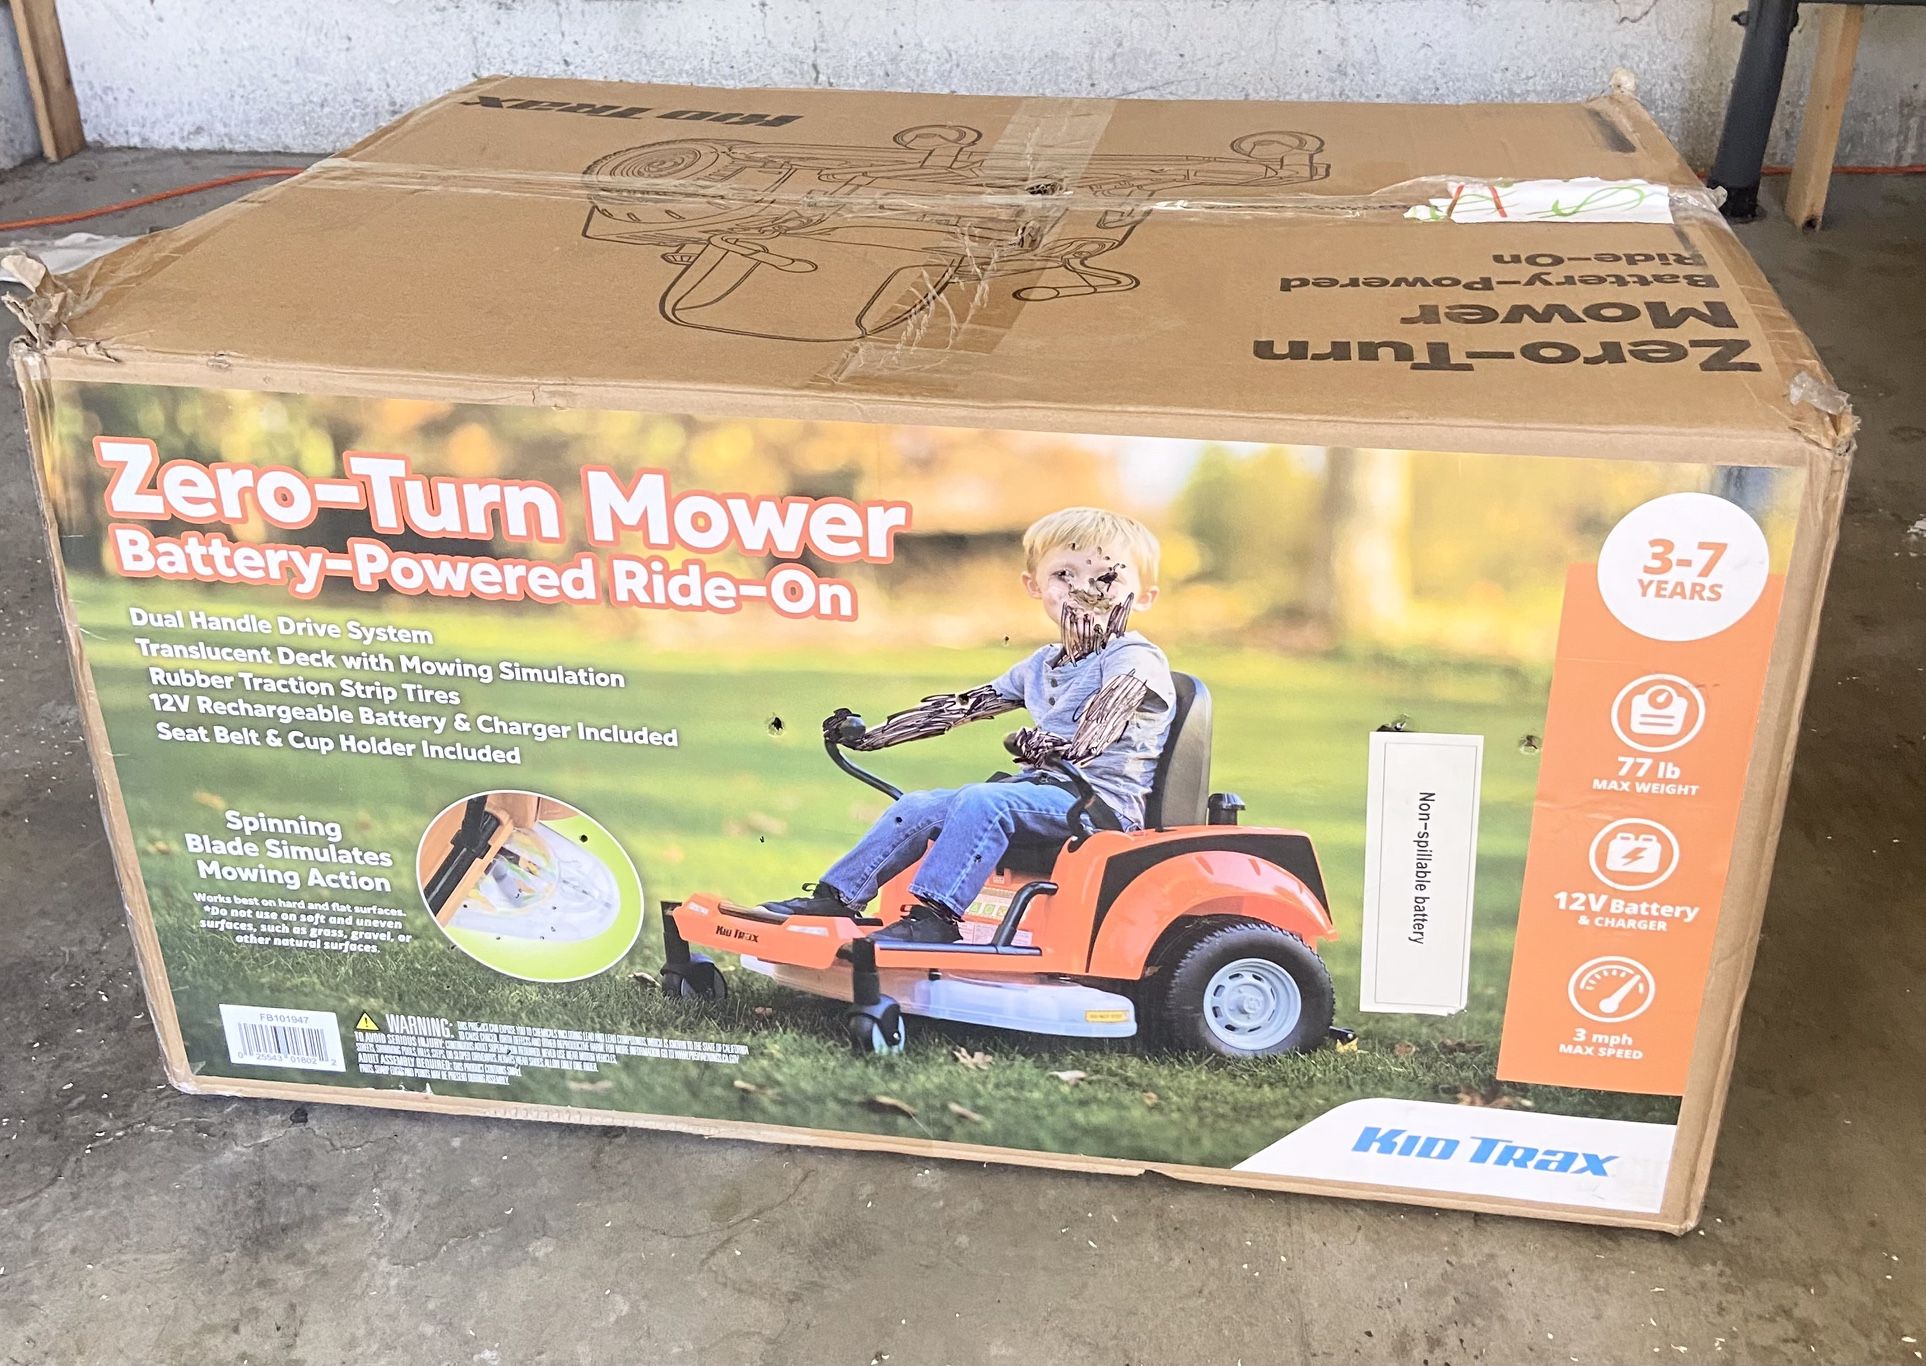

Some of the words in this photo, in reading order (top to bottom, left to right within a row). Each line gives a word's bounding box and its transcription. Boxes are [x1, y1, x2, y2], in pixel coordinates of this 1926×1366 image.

[1492, 252, 1707, 266] Ride-On
[1280, 272, 1720, 292] Battery-Powered
[1400, 301, 1739, 330] Mower
[1253, 338, 1762, 372] Zero-Turn
[97, 439, 563, 541] Zero-Turn
[585, 468, 908, 560] Mower
[1643, 538, 1728, 578] 3-7
[113, 528, 598, 601] Battery-Powered
[611, 557, 853, 618] Ride-On
[1637, 579, 1723, 602] YEARS
[129, 607, 184, 628] Dual
[189, 611, 272, 634] Handle
[277, 616, 341, 638] Drive
[346, 620, 433, 645] System
[134, 638, 272, 664] Translucent
[277, 647, 337, 669] Deck
[341, 653, 394, 673] with
[399, 655, 493, 683] Mowing
[498, 661, 625, 688] Simulation
[149, 667, 235, 689] Rubber
[238, 672, 334, 696] Traction
[340, 679, 397, 704] Strip
[401, 683, 461, 705] Tires
[149, 693, 190, 713] 12V
[196, 696, 354, 724] Rechargeable
[359, 707, 447, 735] Battery
[454, 713, 471, 732] &
[476, 716, 571, 741] Charger
[577, 722, 678, 747] Included
[156, 722, 210, 743] Seat
[213, 726, 261, 746] Belt
[266, 729, 283, 747] &
[288, 732, 334, 754] Cup
[339, 735, 415, 757] Holder
[422, 740, 521, 765] Included
[1617, 756, 1654, 777] 77
[1657, 762, 1681, 779] lb
[1592, 779, 1630, 791] MAX
[1635, 781, 1699, 796] WEIGHT
[224, 810, 342, 842] Spinning
[184, 833, 260, 857] Blade
[265, 839, 393, 868] Simulates
[1413, 792, 1436, 891] Non-spillable
[196, 860, 301, 890] Mowing
[307, 868, 392, 892] Action
[193, 892, 232, 904] Works
[234, 895, 260, 906] best
[261, 898, 276, 907] on
[278, 898, 305, 910] hard
[307, 900, 329, 911] and
[332, 902, 351, 913] flat
[354, 905, 407, 917] surfaces.
[1553, 891, 1609, 911] 12V
[1610, 899, 1700, 922] Battery
[200, 919, 257, 933] surfaces,
[260, 922, 289, 934] such
[293, 926, 307, 935] as
[310, 926, 348, 939] grass,
[351, 928, 394, 941] gravel,
[398, 933, 412, 943] or
[231, 908, 252, 918] not
[256, 910, 278, 919] use
[281, 912, 297, 921] on
[300, 912, 326, 925] soft
[328, 914, 353, 926] and
[355, 917, 402, 929] uneven
[1408, 895, 1431, 945] battery
[1578, 916, 1590, 925] &
[1594, 917, 1667, 932] CHARGER
[235, 933, 271, 944] other
[273, 935, 321, 949] natural
[324, 940, 380, 953] surfaces.
[260, 1013, 309, 1024] FB101947
[385, 1014, 454, 1038] WARNING:
[354, 1031, 364, 1042] TO
[365, 1032, 386, 1043] AVOID
[387, 1034, 417, 1046] SERIOUS
[1573, 1028, 1586, 1042] 3
[1592, 1033, 1633, 1047] mph
[358, 1052, 379, 1064] ADULT
[380, 1054, 415, 1067] ASSEMBLY
[416, 1057, 453, 1070] REQUIRED:
[1559, 1044, 1594, 1056] MAX
[1598, 1047, 1643, 1060] SPEED
